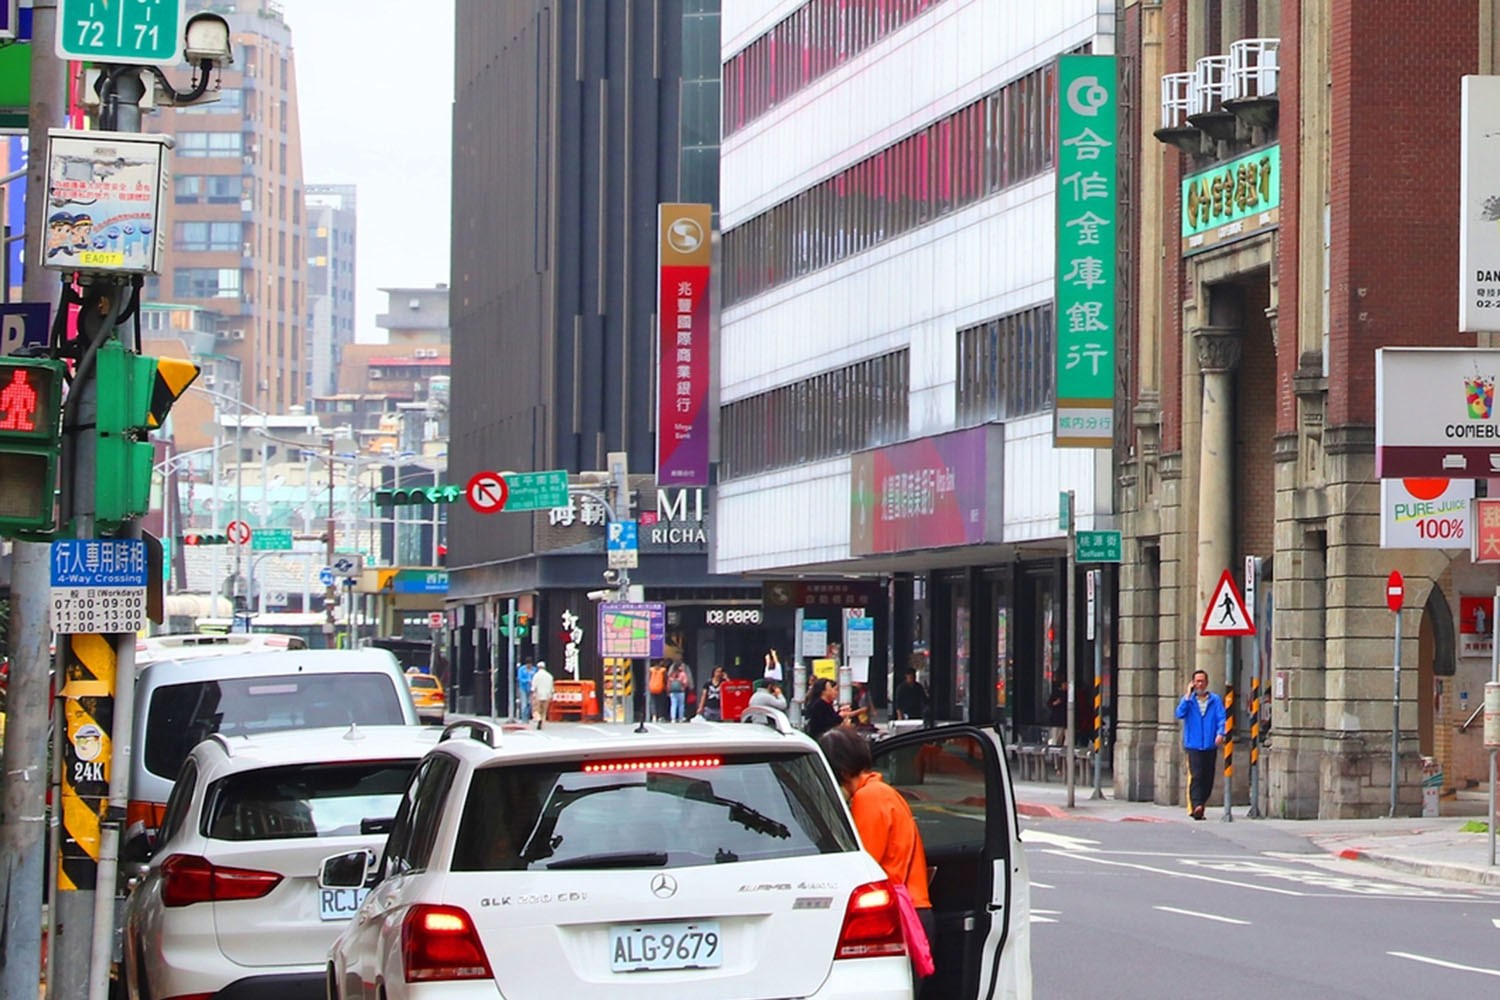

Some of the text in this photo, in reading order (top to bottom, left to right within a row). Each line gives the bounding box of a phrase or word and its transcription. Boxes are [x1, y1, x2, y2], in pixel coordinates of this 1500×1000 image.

[78, 20, 105, 47] 72
[134, 24, 159, 51] 71
[84, 253, 117, 264] EA017
[1062, 127, 1113, 376] 合作金庫銀行
[1394, 499, 1466, 521] PURE JUICE
[1415, 518, 1464, 539] 100%
[56, 542, 144, 573] 行人專用時相
[58, 574, 142, 585] 4-Way Crossing
[97, 588, 144, 598] (Workdays)
[55, 598, 141, 609] 07:00-09:00
[56, 610, 141, 620] 11:00-13:00
[56, 621, 141, 632] 17:00-19:00
[74, 762, 104, 782] 24K
[481, 896, 512, 907] GLK
